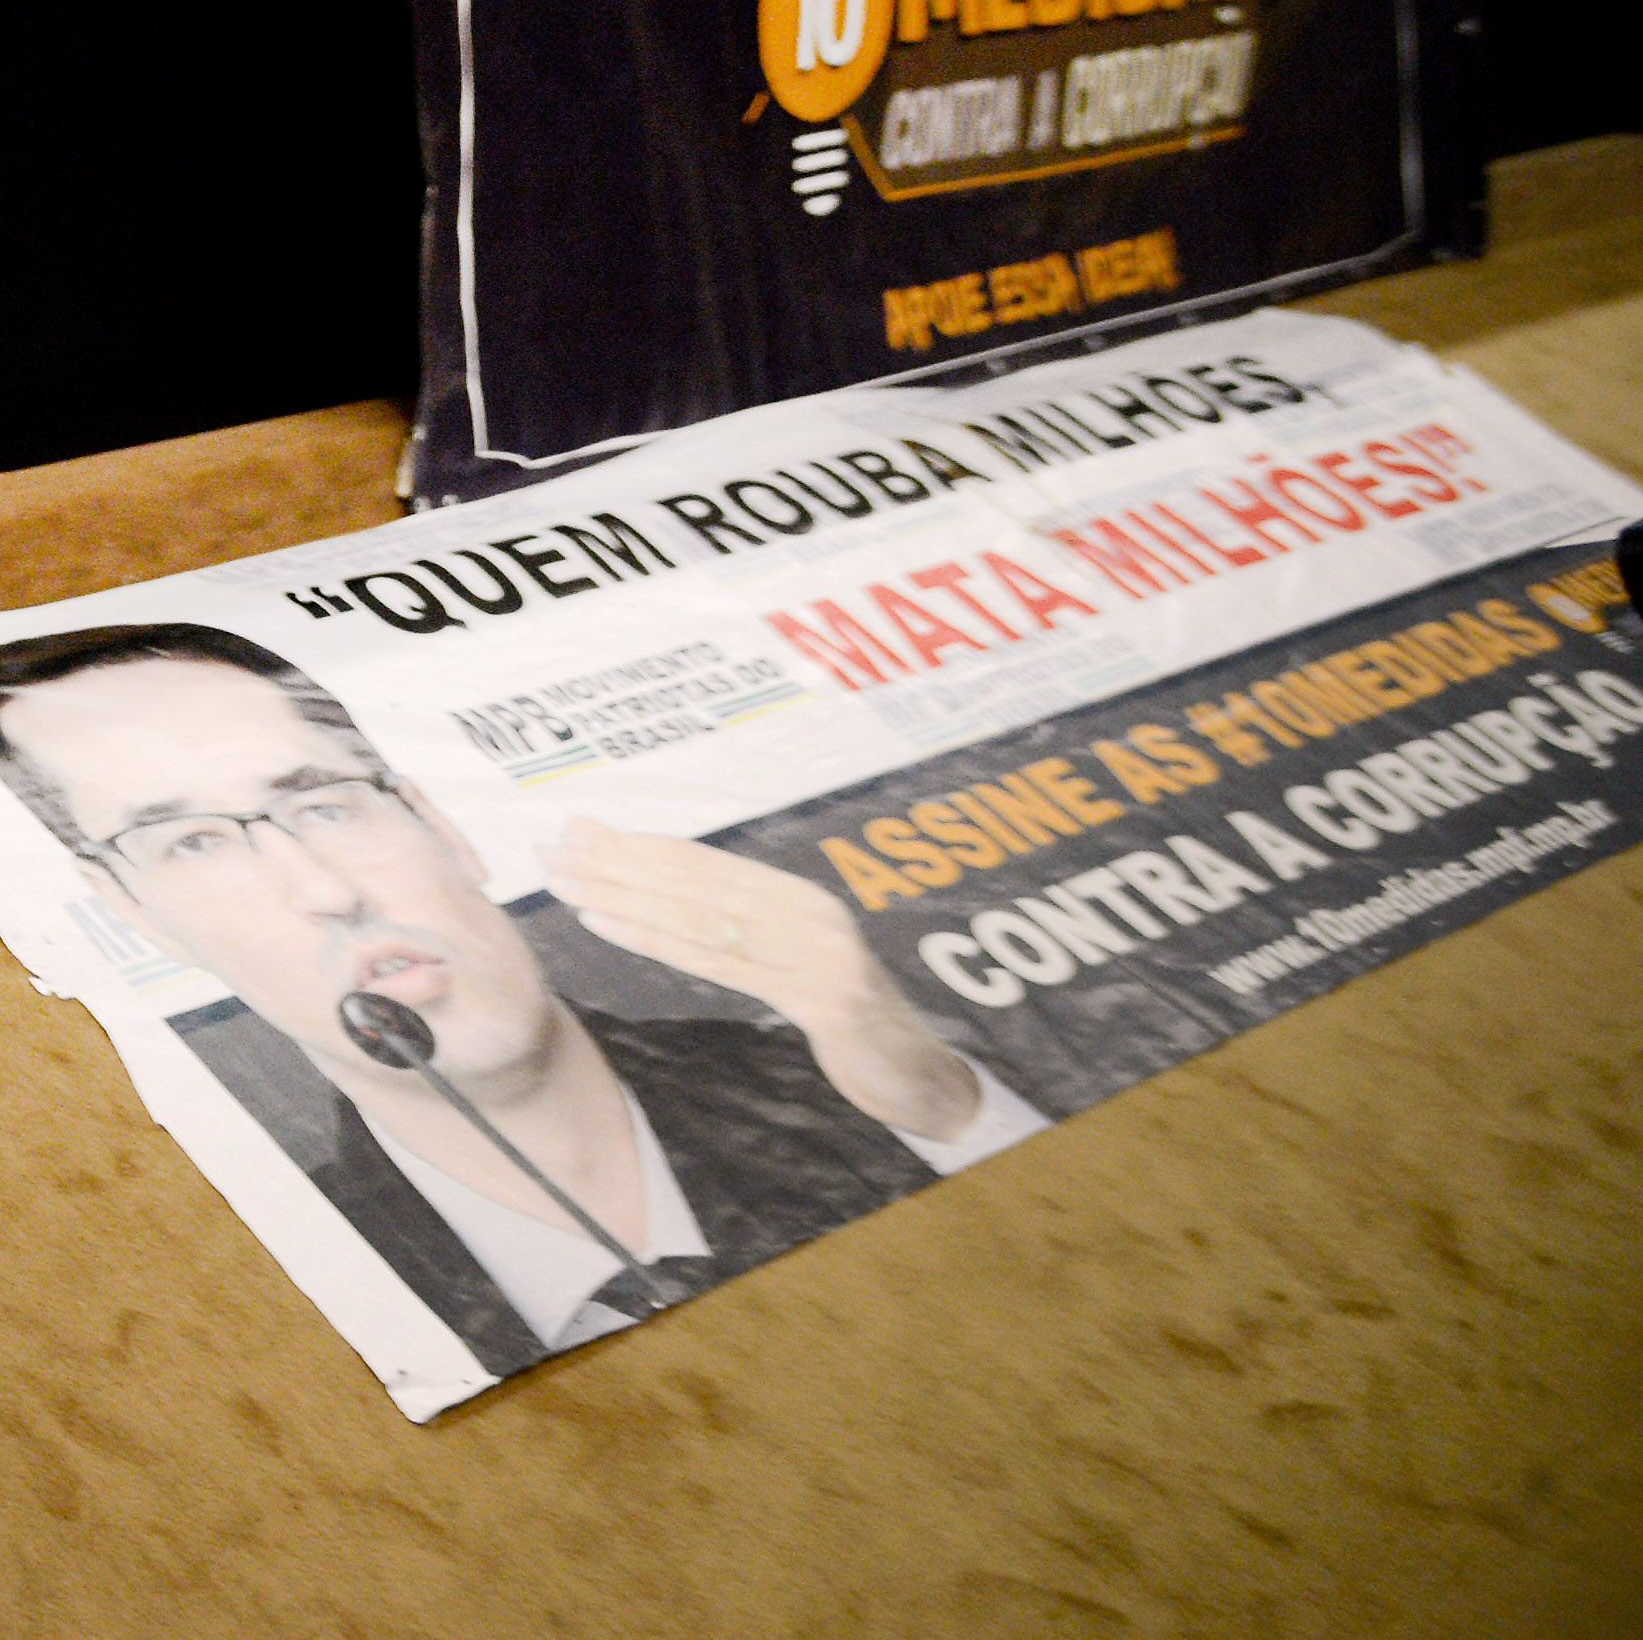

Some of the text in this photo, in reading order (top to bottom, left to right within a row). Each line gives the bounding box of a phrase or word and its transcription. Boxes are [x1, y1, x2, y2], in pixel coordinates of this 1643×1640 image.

[878, 75, 1024, 170] CONTRA
[655, 435, 995, 557] ROUBA
[765, 548, 1101, 694] MATA
[450, 693, 575, 762] MPB
[598, 710, 717, 762] BRASIL
[817, 757, 1127, 915] ASSINE
[1088, 721, 1222, 807] AS
[1187, 597, 1563, 768] #10MEDIDAS
[916, 834, 1275, 1011] CONTRA
[1223, 810, 1333, 884] A
[1283, 670, 1643, 854] CORRUPÇÃO
